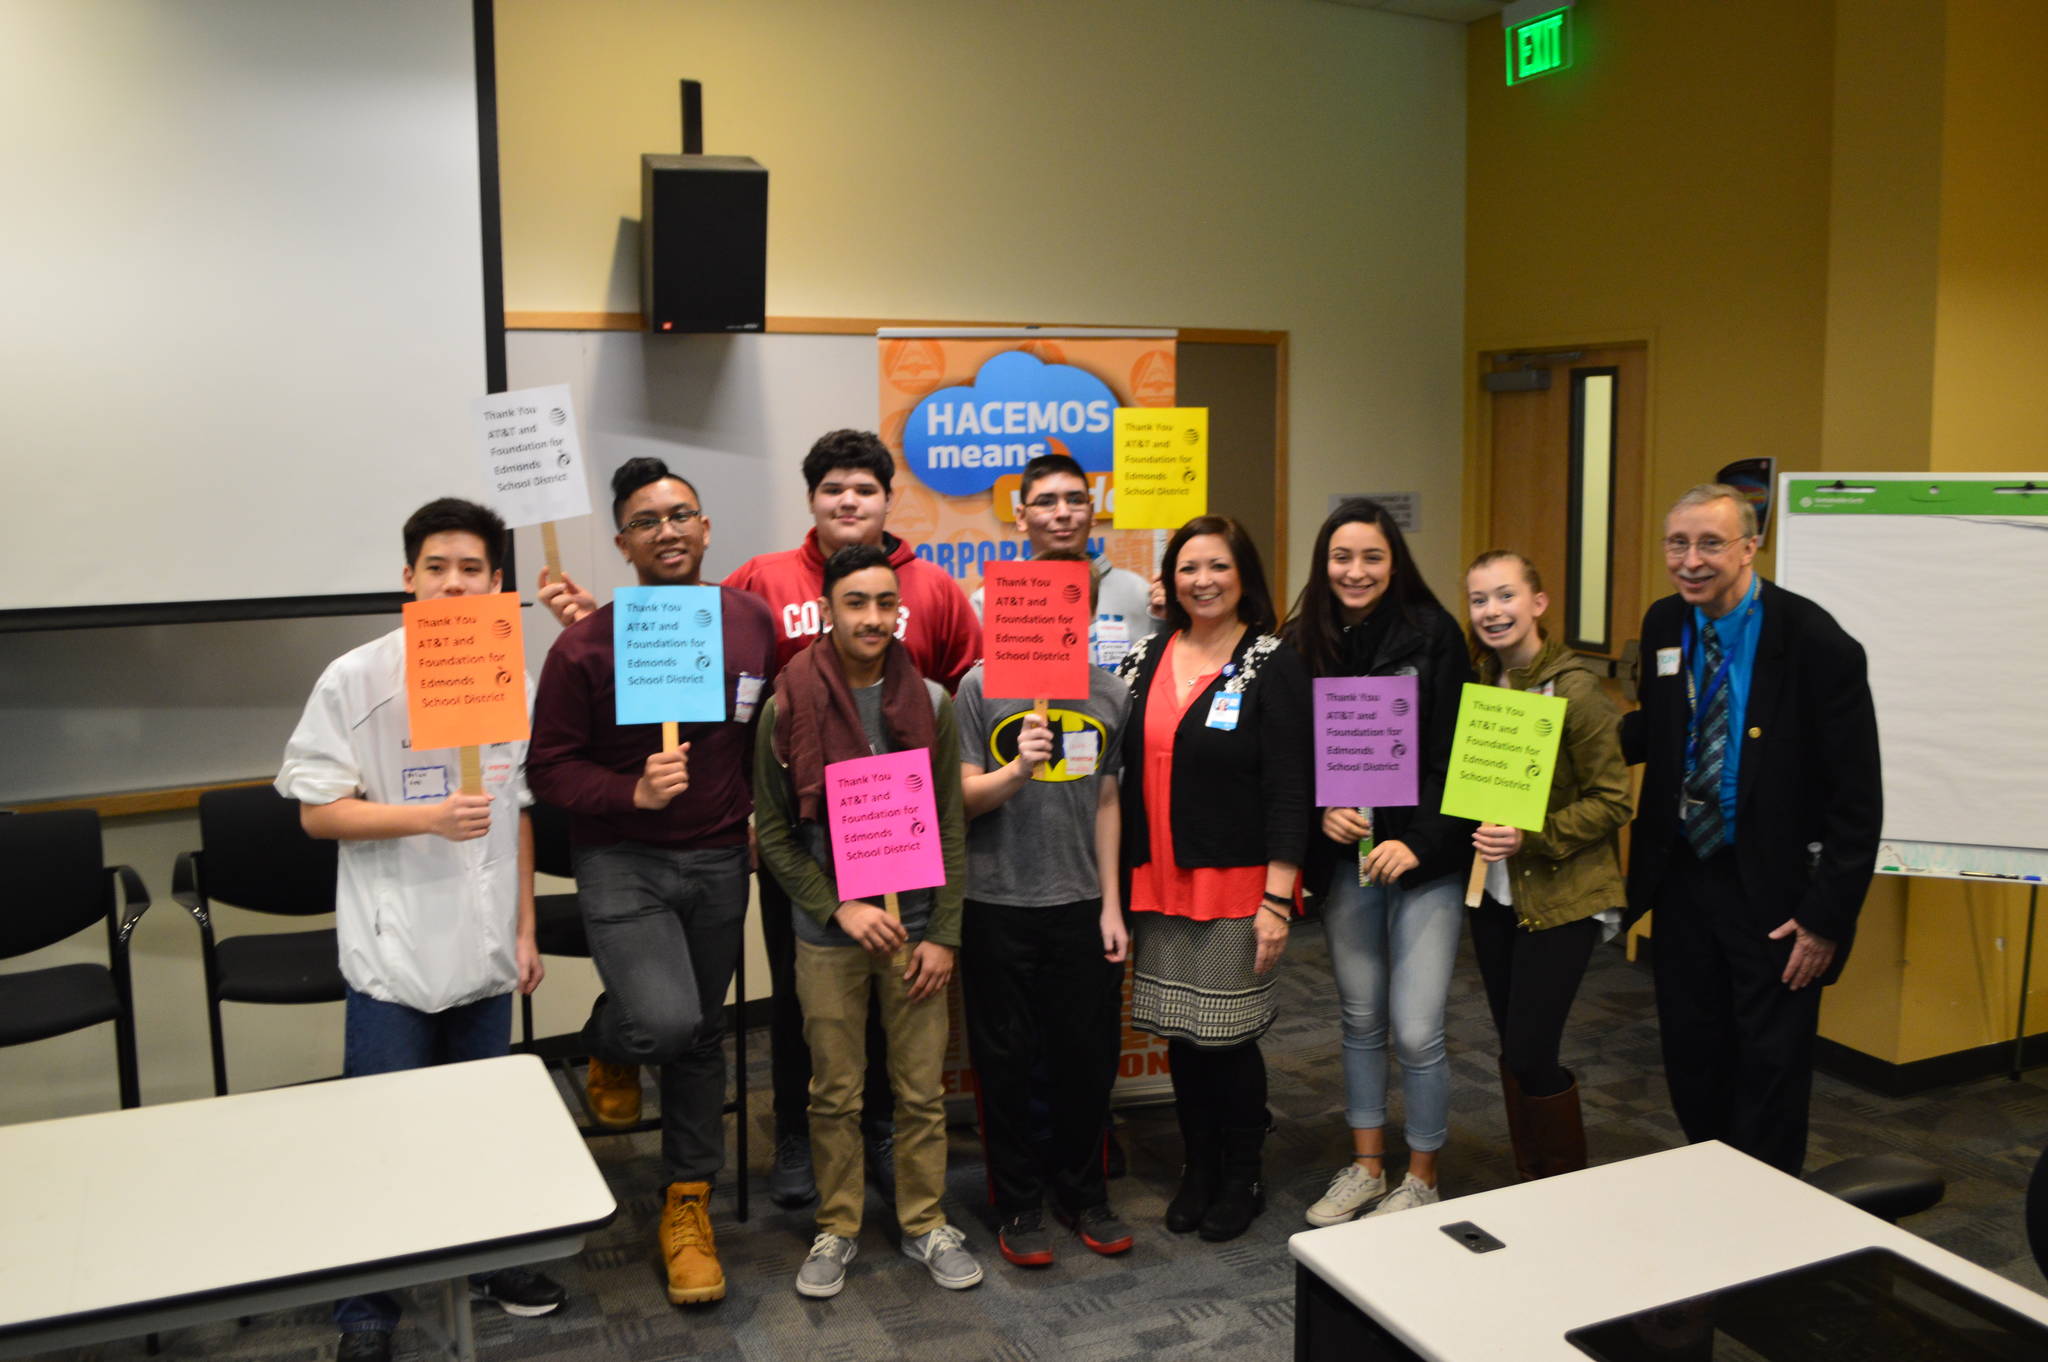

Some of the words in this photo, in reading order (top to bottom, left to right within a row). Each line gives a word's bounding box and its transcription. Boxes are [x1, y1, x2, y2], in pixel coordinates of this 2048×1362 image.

[1517, 14, 1563, 78] EXIT
[484, 409, 514, 420] Thank
[517, 407, 536, 415] You
[927, 400, 1110, 435] HACEMOS
[488, 427, 515, 439] AT&T
[519, 425, 537, 435] and
[1125, 423, 1152, 431] Thank
[490, 441, 547, 456] Foundation
[1124, 440, 1150, 448] AT&T
[1152, 440, 1170, 448] and
[927, 442, 1045, 468] means
[494, 461, 541, 475] Edmonds
[1125, 472, 1167, 480] Edmonds
[497, 479, 530, 492] School
[534, 473, 567, 486] District
[996, 577, 1027, 587] Thank
[1031, 578, 1050, 587] You
[627, 603, 657, 612] Thank
[996, 597, 1024, 606] AT&T
[1027, 597, 1047, 606] and
[417, 618, 450, 628] Thank
[996, 615, 1055, 624] Foundation
[1058, 615, 1073, 624] for
[626, 623, 655, 632] AT&T
[659, 622, 679, 630] and
[418, 638, 448, 648] AT&T
[453, 636, 474, 646] and
[627, 640, 687, 649] Foundation
[691, 639, 706, 648] for
[996, 634, 1044, 643] Edmonds
[419, 656, 485, 667] Foundation
[489, 653, 505, 662] for
[996, 652, 1029, 661] School
[1033, 651, 1070, 661] District
[628, 658, 677, 668] Edmonds
[421, 677, 474, 688] Edmonds
[628, 676, 662, 685] School
[667, 675, 704, 684] District
[422, 697, 460, 708] School
[465, 693, 505, 704] District
[1326, 693, 1356, 701] Thank
[1473, 701, 1502, 713] Thank
[1506, 707, 1525, 716] You
[1327, 728, 1384, 736] Foundation
[1386, 728, 1402, 736] for
[1469, 720, 1496, 729] AT&T
[1498, 725, 1518, 735] and
[1327, 746, 1374, 755] Edmonds
[1466, 736, 1523, 753] Foundation
[1526, 746, 1540, 756] for
[1326, 763, 1360, 771] School
[1363, 763, 1400, 771] District
[1463, 754, 1508, 769] Edmonds
[838, 777, 868, 788] Thank
[873, 774, 891, 783] You
[1460, 771, 1492, 785] School
[1494, 777, 1530, 791] District
[840, 795, 868, 807] AT&T
[872, 792, 890, 802] and
[842, 808, 900, 824] Foundation
[904, 805, 919, 814] for
[845, 829, 893, 843] Edmonds
[847, 848, 880, 861] School
[884, 842, 920, 855] District
